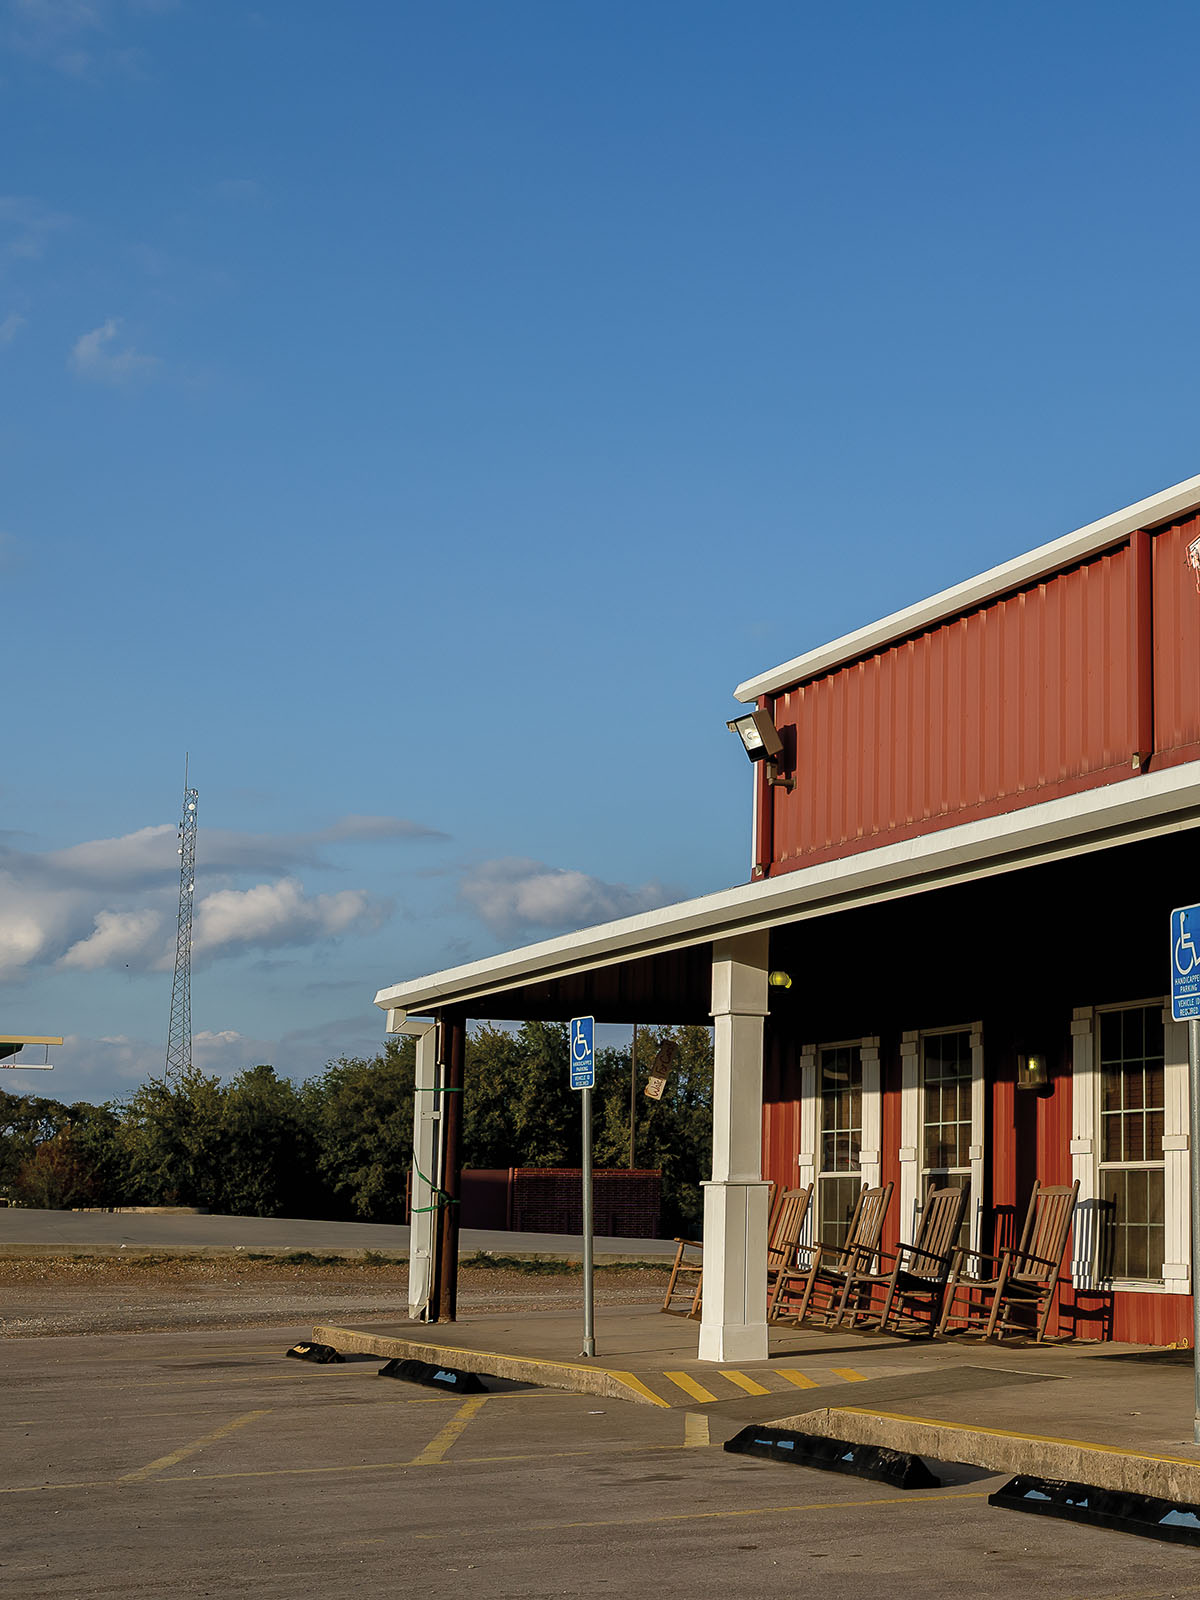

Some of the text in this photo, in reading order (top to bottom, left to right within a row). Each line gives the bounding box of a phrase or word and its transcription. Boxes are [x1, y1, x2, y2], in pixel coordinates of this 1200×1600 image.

[1180, 984, 1198, 993] PARKING
[1178, 997, 1200, 1008] VEHICLE ID
